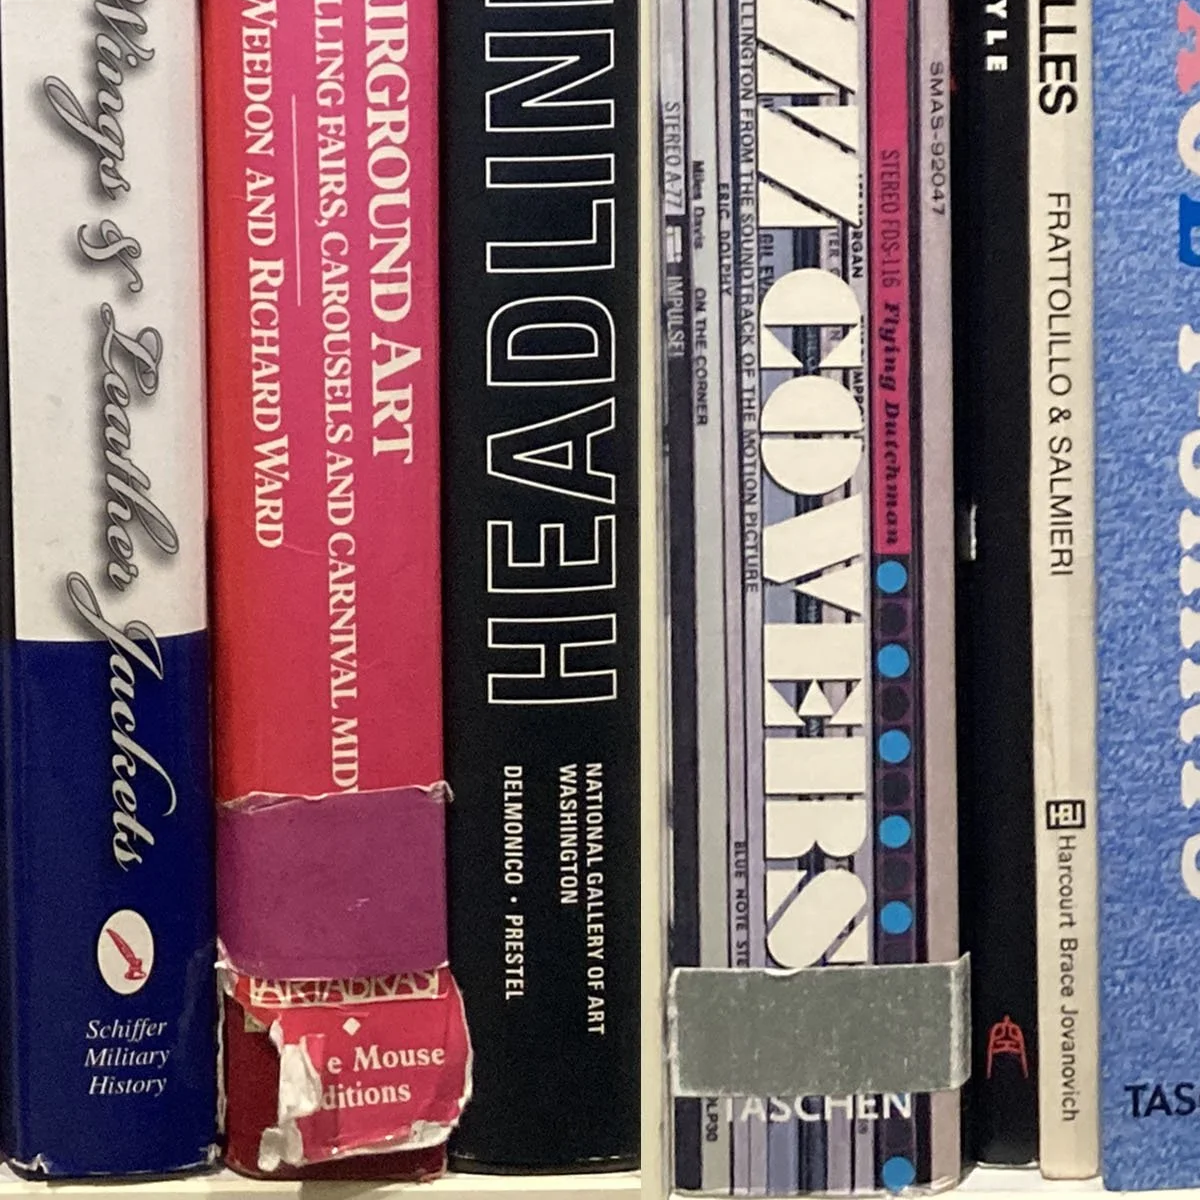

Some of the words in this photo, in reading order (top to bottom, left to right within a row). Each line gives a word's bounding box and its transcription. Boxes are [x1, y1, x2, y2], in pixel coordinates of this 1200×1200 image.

[314, 115, 348, 227] FAIRS,
[741, 108, 757, 162] FROM
[931, 61, 946, 216] SMAS-92047
[245, 167, 277, 247] AND
[742, 170, 757, 207] THE
[882, 150, 901, 214] STEREO
[77, 218, 144, 292] &
[742, 214, 758, 347] SOUNDTRACK
[883, 219, 902, 288] FDS-116
[1047, 192, 1073, 397] FRATTOLILLO
[248, 257, 285, 432] RICHARD
[320, 231, 353, 444] CAROUSELS
[743, 354, 758, 379] OF
[879, 302, 900, 391] Flying
[370, 332, 422, 464] ART
[744, 385, 759, 422] THE
[1048, 406, 1072, 425] &
[98, 302, 180, 594] Leather
[253, 435, 290, 548] WARD
[326, 449, 355, 526] AND
[744, 429, 760, 504] MOTION
[885, 400, 902, 545] Dutchman
[1048, 435, 1074, 576] SALMIERI
[745, 511, 762, 593] PICTURE
[327, 531, 358, 709] CARNIVAL
[760, 267, 868, 969] COVERS
[66, 571, 178, 872] Jackets
[331, 716, 359, 794] MID
[503, 765, 524, 885] DELMONICO
[559, 763, 579, 904] WASHINGTON
[585, 762, 604, 868] NATIONAL
[586, 872, 604, 960] GALLERY
[1057, 834, 1077, 929] Harcourt
[504, 914, 524, 1001] PRESTEL
[587, 966, 605, 991] OF
[1059, 937, 1079, 998] Brace
[85, 1046, 171, 1070] Military
[86, 1019, 168, 1041] Schiffer
[353, 1045, 445, 1072] Mouse
[587, 995, 605, 1035] ART
[88, 1075, 168, 1099] History
[322, 1082, 412, 1110] ditions
[1060, 1004, 1081, 1122] Jovanovich
